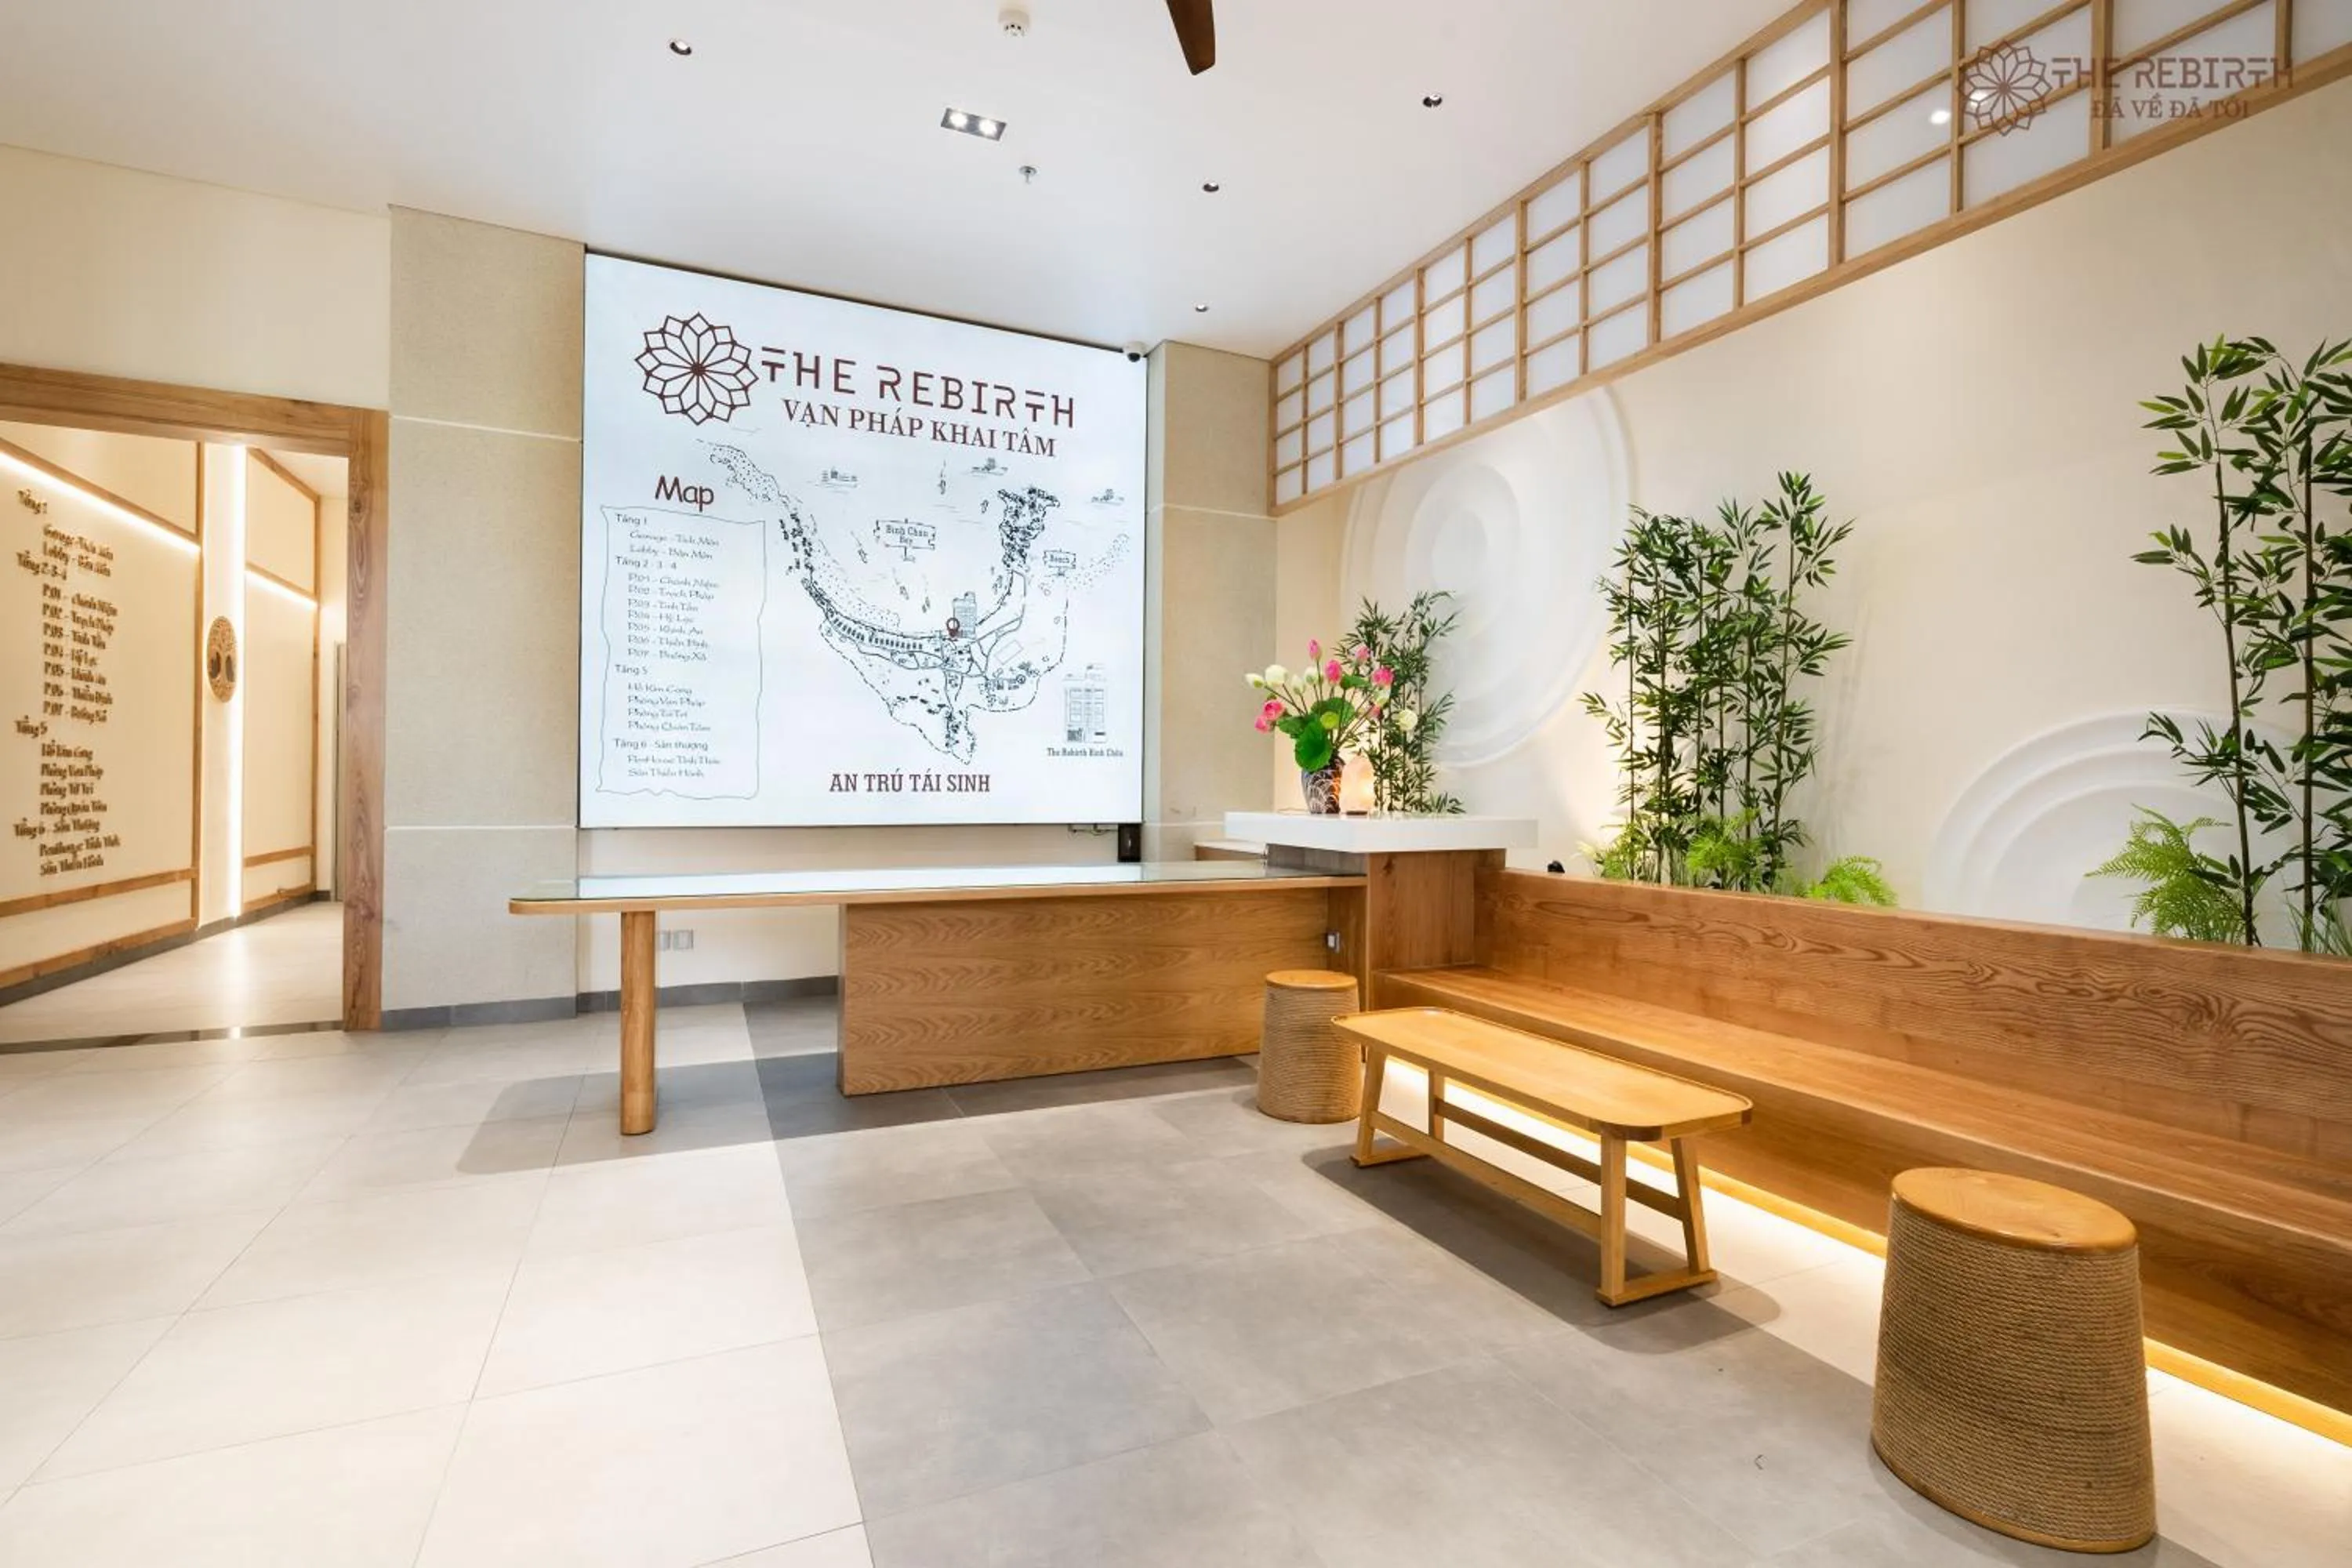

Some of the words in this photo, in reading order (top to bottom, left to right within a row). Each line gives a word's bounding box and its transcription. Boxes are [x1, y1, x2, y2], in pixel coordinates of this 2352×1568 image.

[761, 345, 856, 392] THE
[877, 365, 1074, 428] REBIRTH
[783, 398, 840, 426] VẠN
[848, 406, 923, 439] PHÁP
[932, 419, 995, 449] KHAI
[1003, 426, 1056, 457] TÂM
[655, 475, 714, 513] Map
[829, 774, 858, 792] AN
[864, 768, 903, 792] TRÚ
[909, 768, 941, 792] TÁI
[947, 774, 990, 793] SINH
